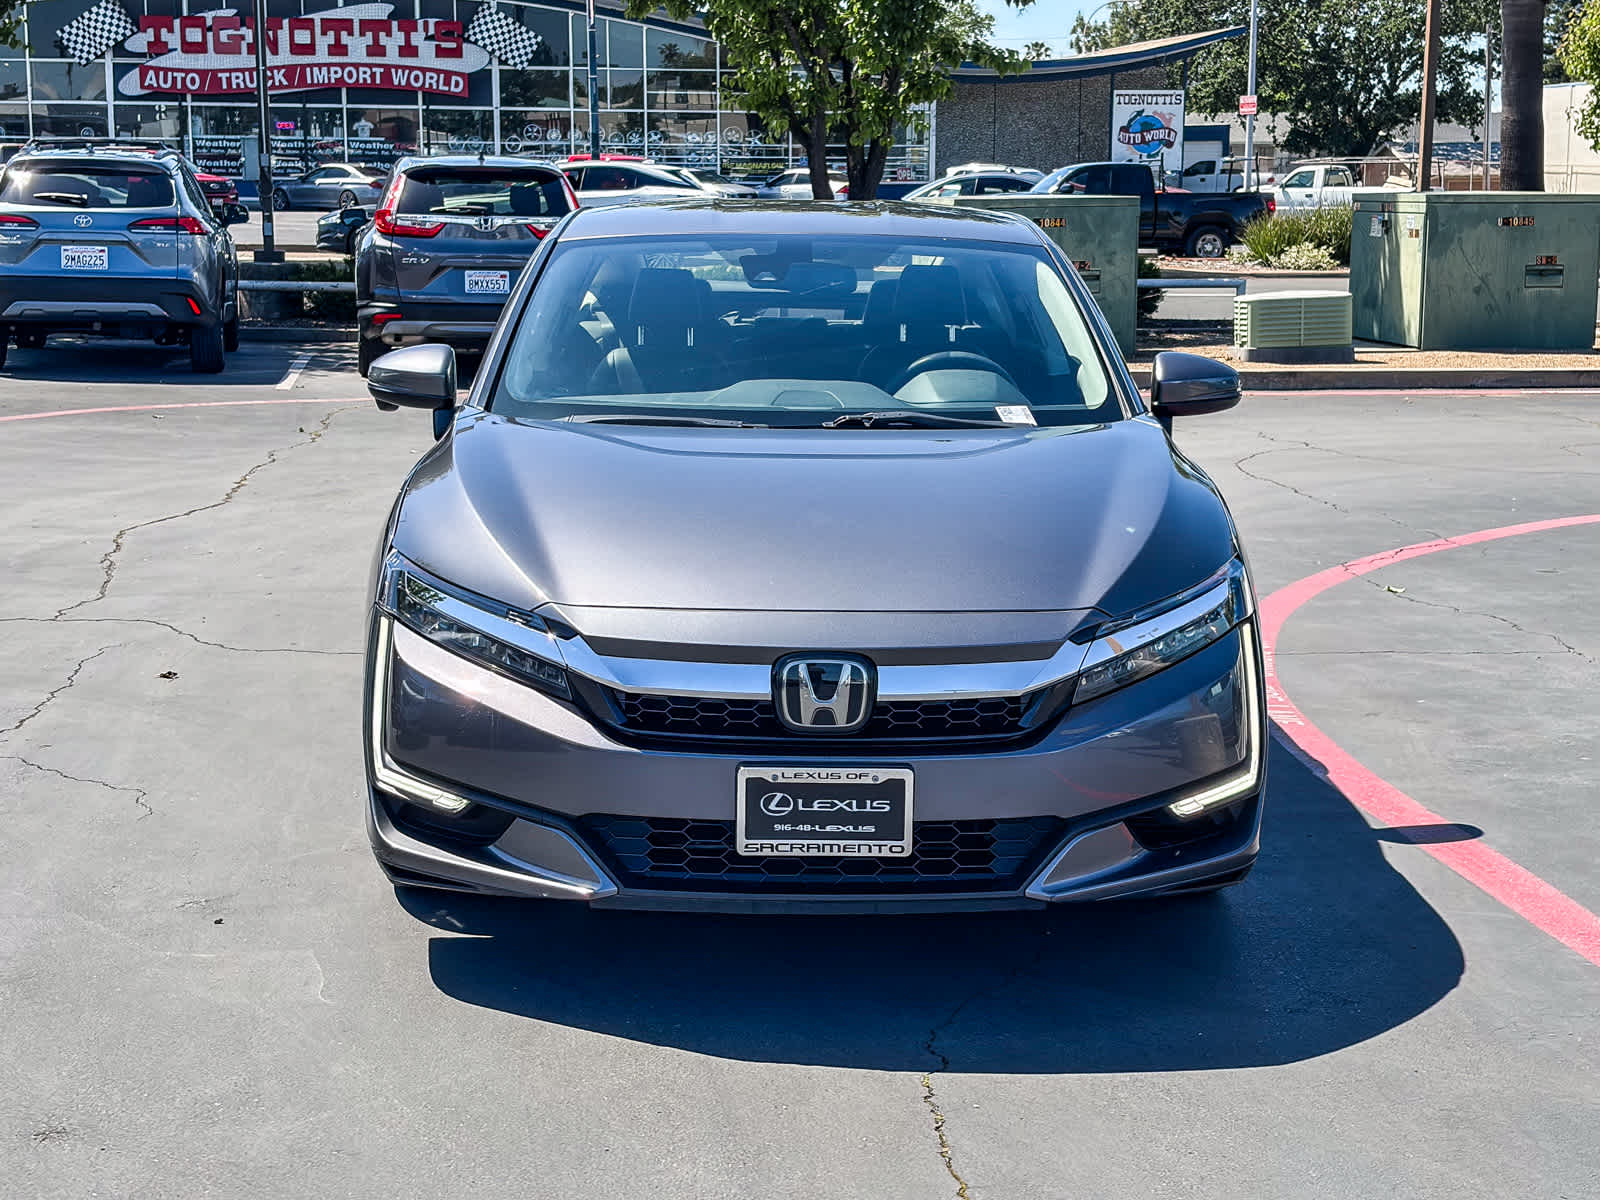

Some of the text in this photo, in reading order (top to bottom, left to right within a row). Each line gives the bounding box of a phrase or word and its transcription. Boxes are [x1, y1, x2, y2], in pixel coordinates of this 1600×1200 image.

[140, 15, 463, 58] TOGNOTTI'S
[144, 69, 200, 90] AUTO
[305, 66, 384, 84] IMPORT
[391, 67, 464, 93] WORLD
[1143, 129, 1176, 143] WORLD
[64, 254, 105, 266] 9MAG225
[468, 279, 506, 290] 8MXX557
[781, 772, 871, 781] LEXUS OF
[797, 798, 892, 813] LEXUS
[743, 842, 906, 855] SACRAMENTO
